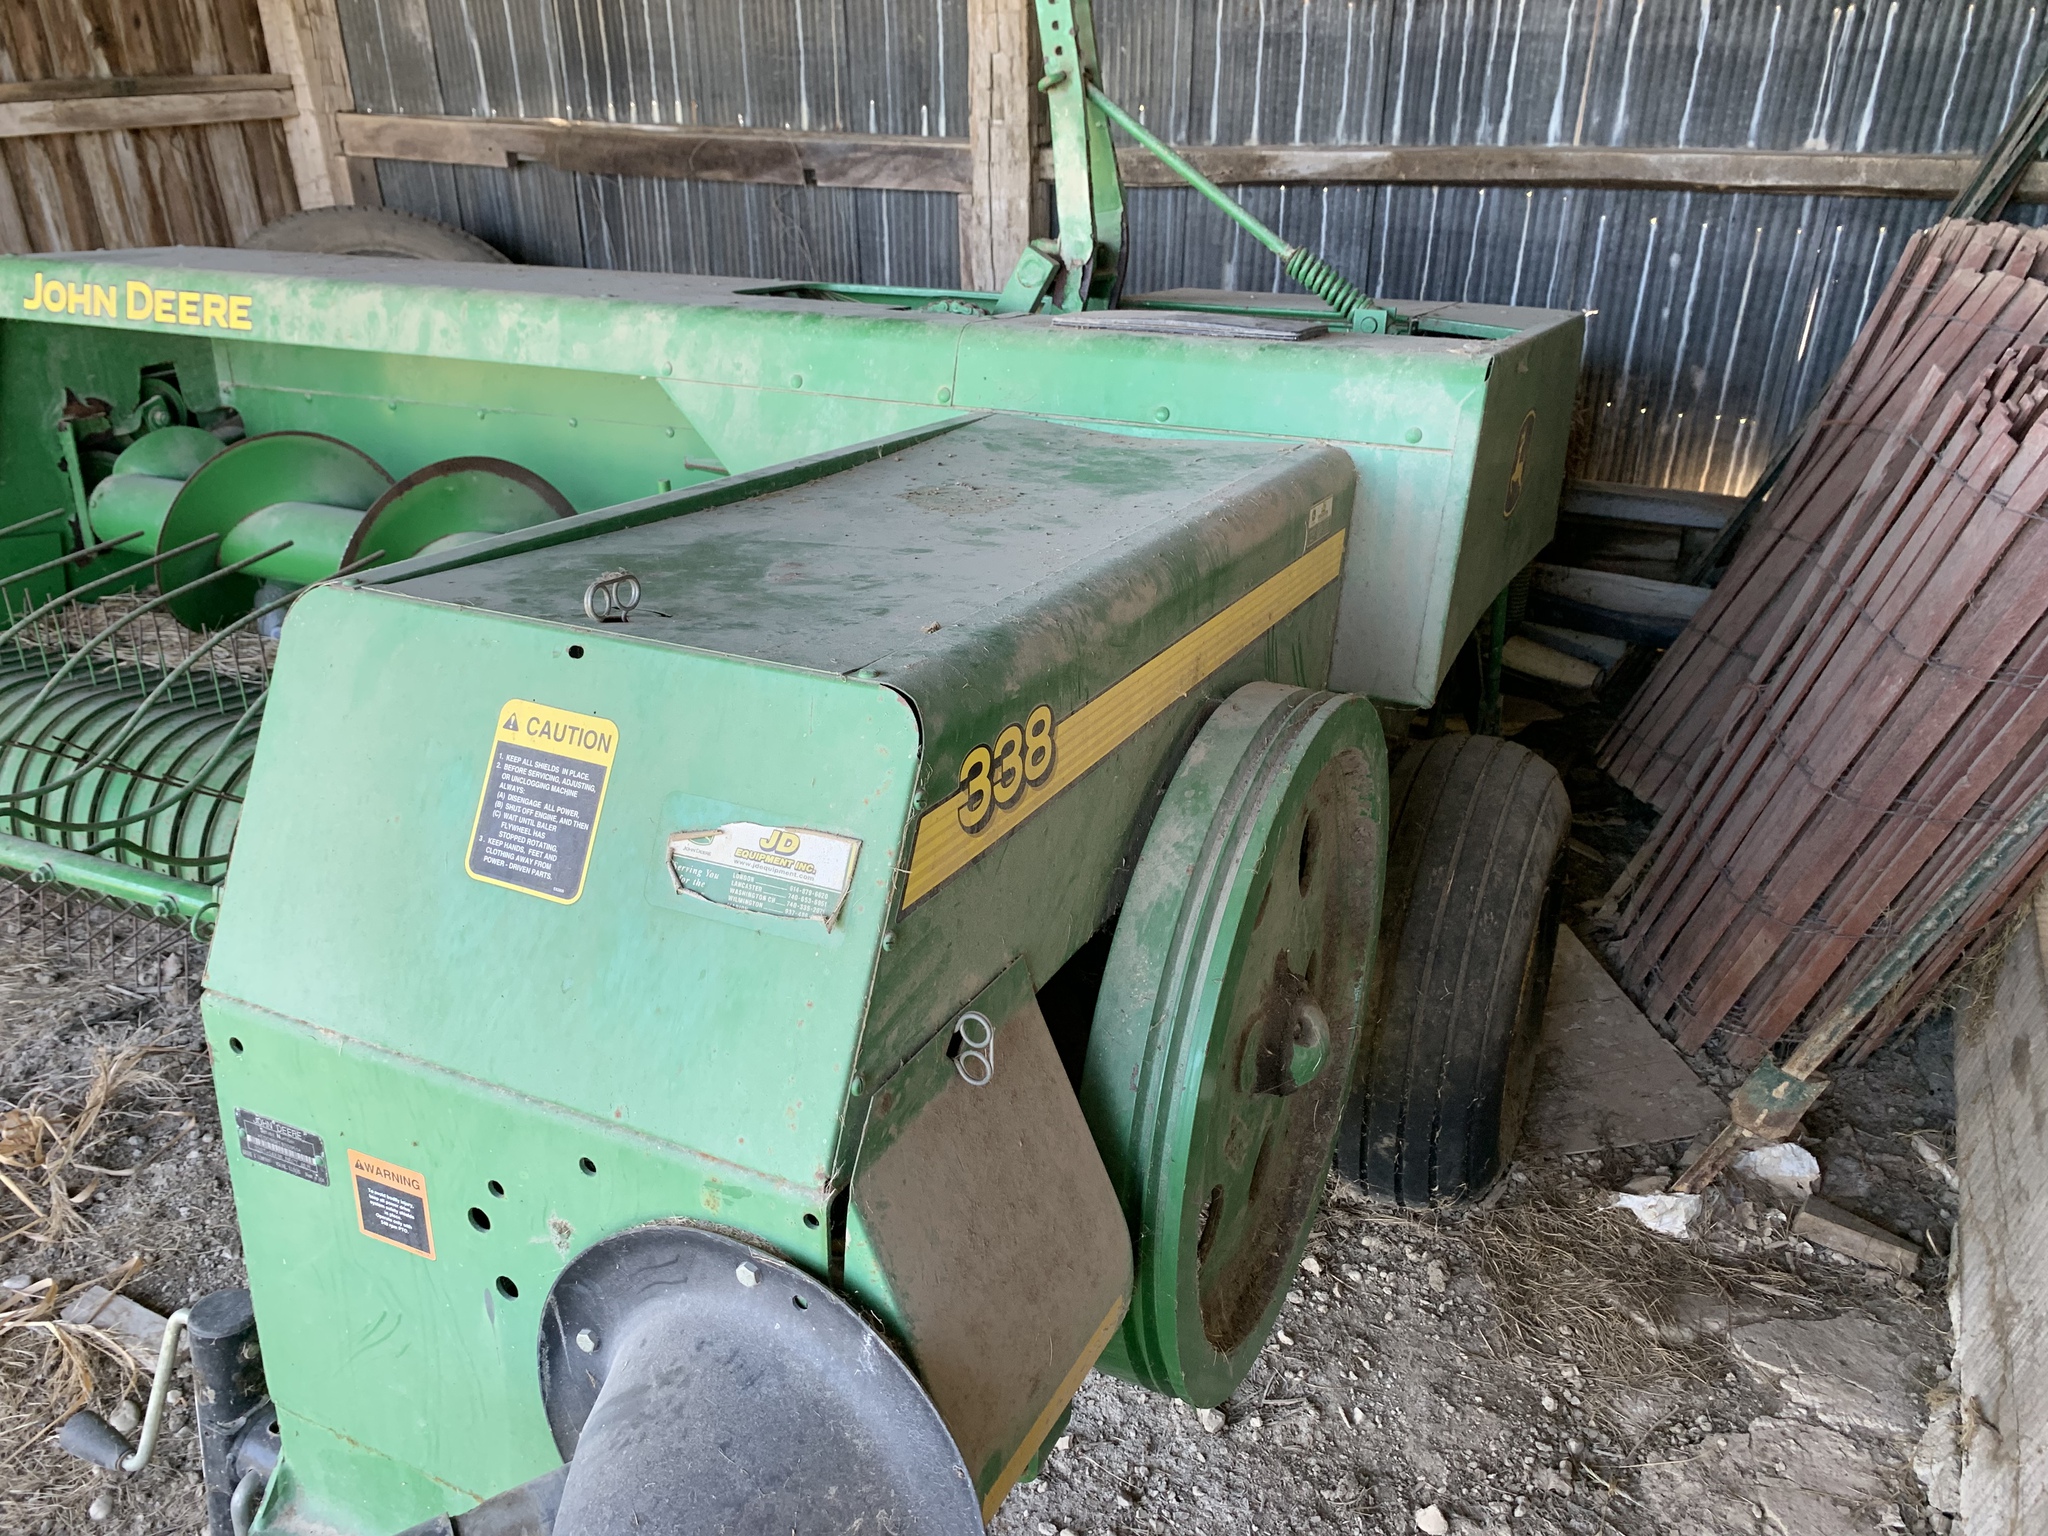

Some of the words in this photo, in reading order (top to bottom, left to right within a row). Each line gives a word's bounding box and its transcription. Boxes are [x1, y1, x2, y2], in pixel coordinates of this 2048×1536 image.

[23, 272, 117, 319] JOHN
[126, 280, 253, 331] DEERE
[526, 716, 612, 754] CAUTION
[504, 763, 527, 775] BEFORE
[528, 770, 561, 784] SERVICING,
[562, 778, 596, 793] ADJUSTING,
[506, 754, 522, 762] KEEP
[522, 758, 533, 767] ALL
[534, 761, 559, 773] SHIELDS
[569, 770, 590, 781] PLACE.
[958, 704, 1056, 835] 338
[499, 782, 525, 794] ALWAYS:
[511, 774, 550, 791] UNCLOGGING
[551, 785, 578, 798] MACHINE
[494, 800, 503, 809] (B)
[505, 803, 521, 812] SHUT
[522, 807, 534, 816] OFF
[534, 809, 558, 823] ENGINE,
[559, 817, 572, 826] AND
[573, 820, 590, 830] THEN
[497, 791, 505, 800] (A)
[507, 794, 542, 808] DISENGAGE
[544, 804, 555, 812] ALL
[557, 806, 580, 819] POWER,
[492, 810, 501, 819] (C)
[503, 812, 518, 821] WAIT
[519, 815, 535, 826] UNTIL
[537, 821, 557, 832] BALER
[501, 821, 532, 836] FLYWHEEL
[532, 829, 546, 839] HAS
[499, 831, 526, 844] STOPPED
[759, 829, 801, 856] JD
[485, 846, 515, 860] CLOTHING
[515, 855, 533, 865] AWAY
[534, 861, 552, 870] FROM
[487, 838, 503, 847] KEEP
[504, 843, 526, 854] HANDS,
[528, 849, 544, 858] FEET
[544, 852, 558, 862] AND
[734, 847, 795, 869] EQUIPMENT
[794, 861, 817, 875] INC.
[483, 856, 505, 867] POWER
[508, 862, 532, 875] DRIVEN
[531, 869, 553, 880] PARTS.
[673, 861, 703, 877] Serving
[734, 859, 815, 881] www.jdequipment.com
[693, 878, 706, 888] the
[729, 887, 767, 901] WASHINGTON
[731, 880, 763, 892] LANCASTER
[728, 895, 764, 908] WILMINGTON
[276, 1124, 302, 1138] DEERE
[364, 1161, 421, 1190] WARNING
